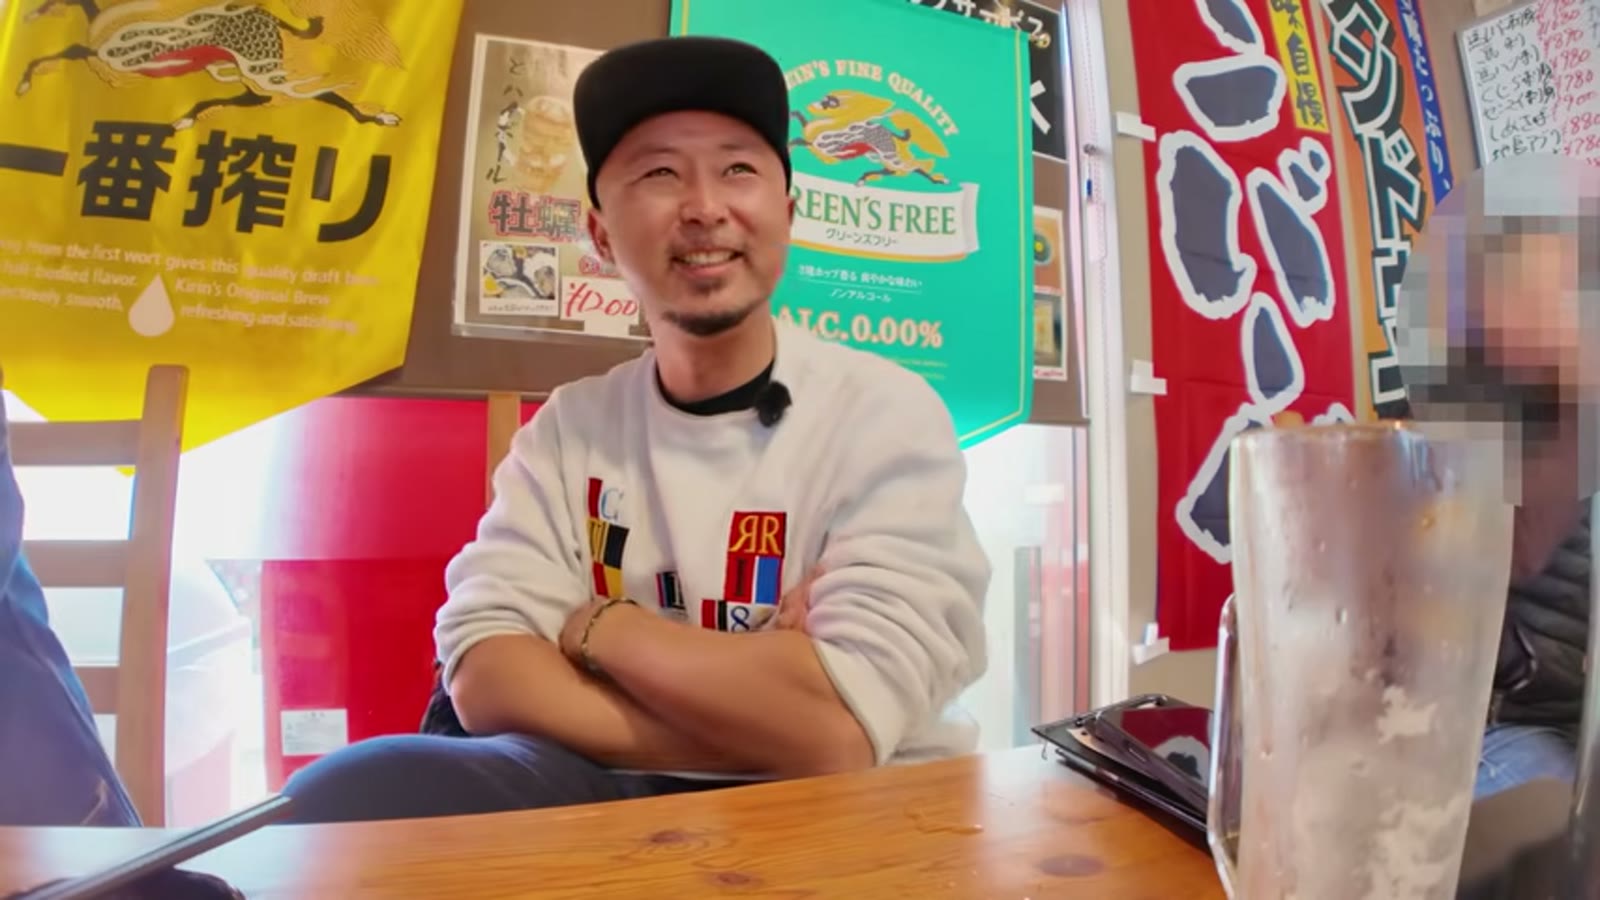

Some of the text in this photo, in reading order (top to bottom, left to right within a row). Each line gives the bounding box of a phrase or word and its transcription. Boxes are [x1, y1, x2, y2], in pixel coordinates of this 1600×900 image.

[834, 59, 883, 82] FINE
[888, 72, 958, 136] QUALITY
[0, 120, 391, 243] 一番搾り
[888, 201, 957, 235] FREE
[66, 243, 90, 260] the
[124, 250, 161, 266] wort
[166, 254, 207, 272] gives
[211, 256, 239, 275] this
[302, 269, 341, 285] draft
[175, 276, 223, 297] Kirin's
[257, 312, 286, 327] and
[851, 313, 944, 349] 0.00%
